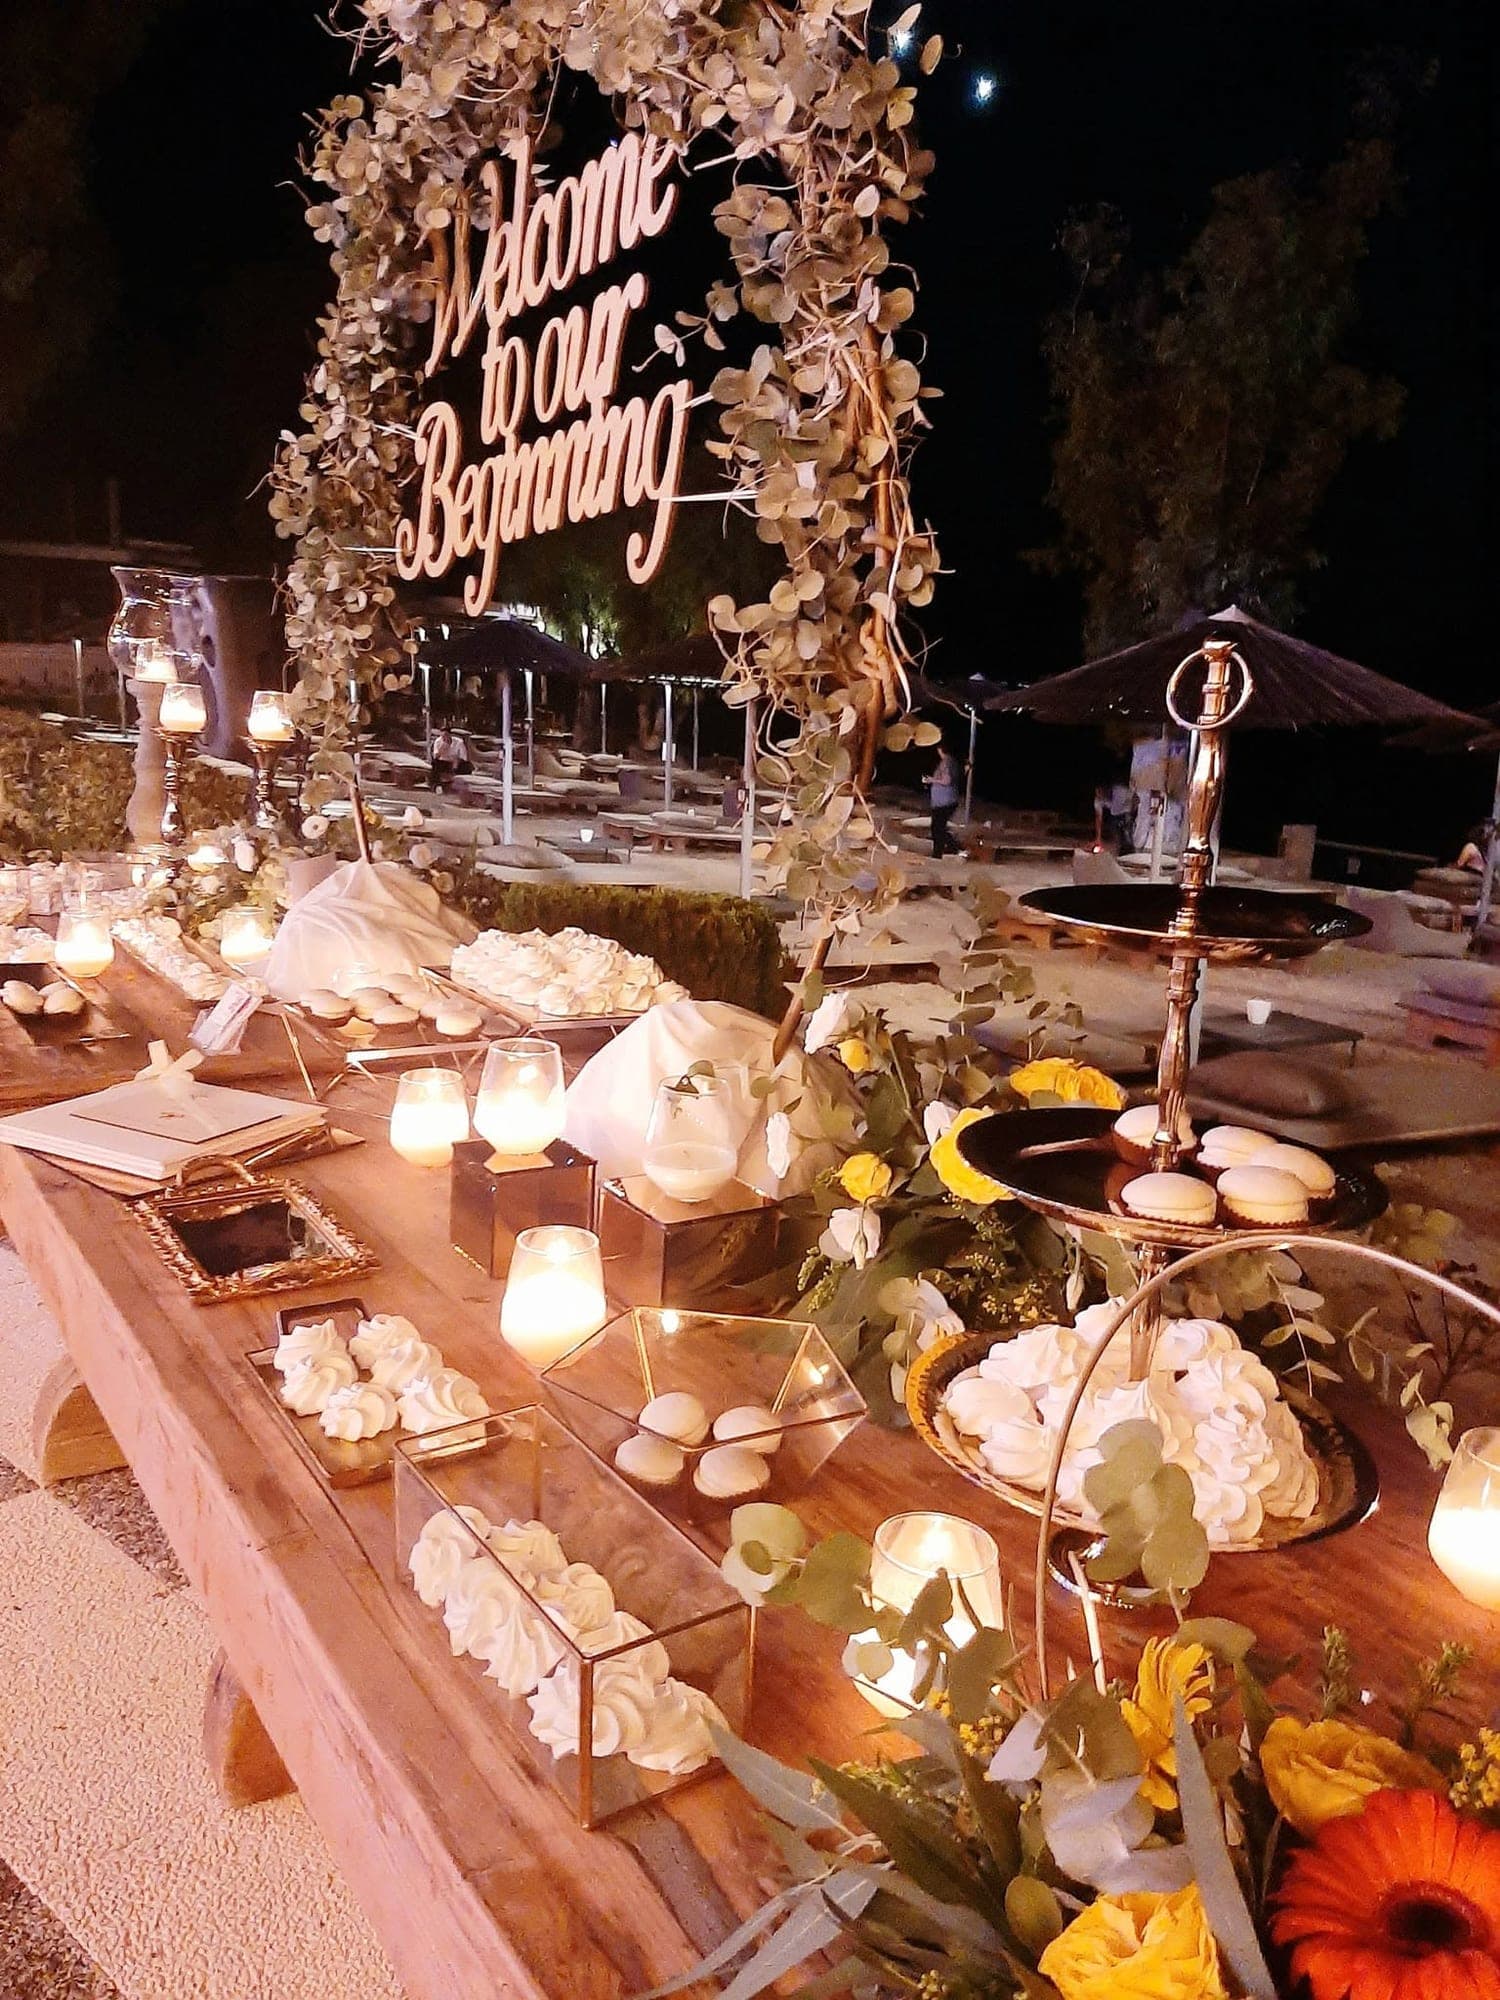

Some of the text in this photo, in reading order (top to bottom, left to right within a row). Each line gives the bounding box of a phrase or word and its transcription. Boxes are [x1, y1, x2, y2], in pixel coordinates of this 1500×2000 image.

[425, 133, 679, 377] Welcome
[482, 272, 650, 445] to our
[395, 378, 693, 618] Beginning
